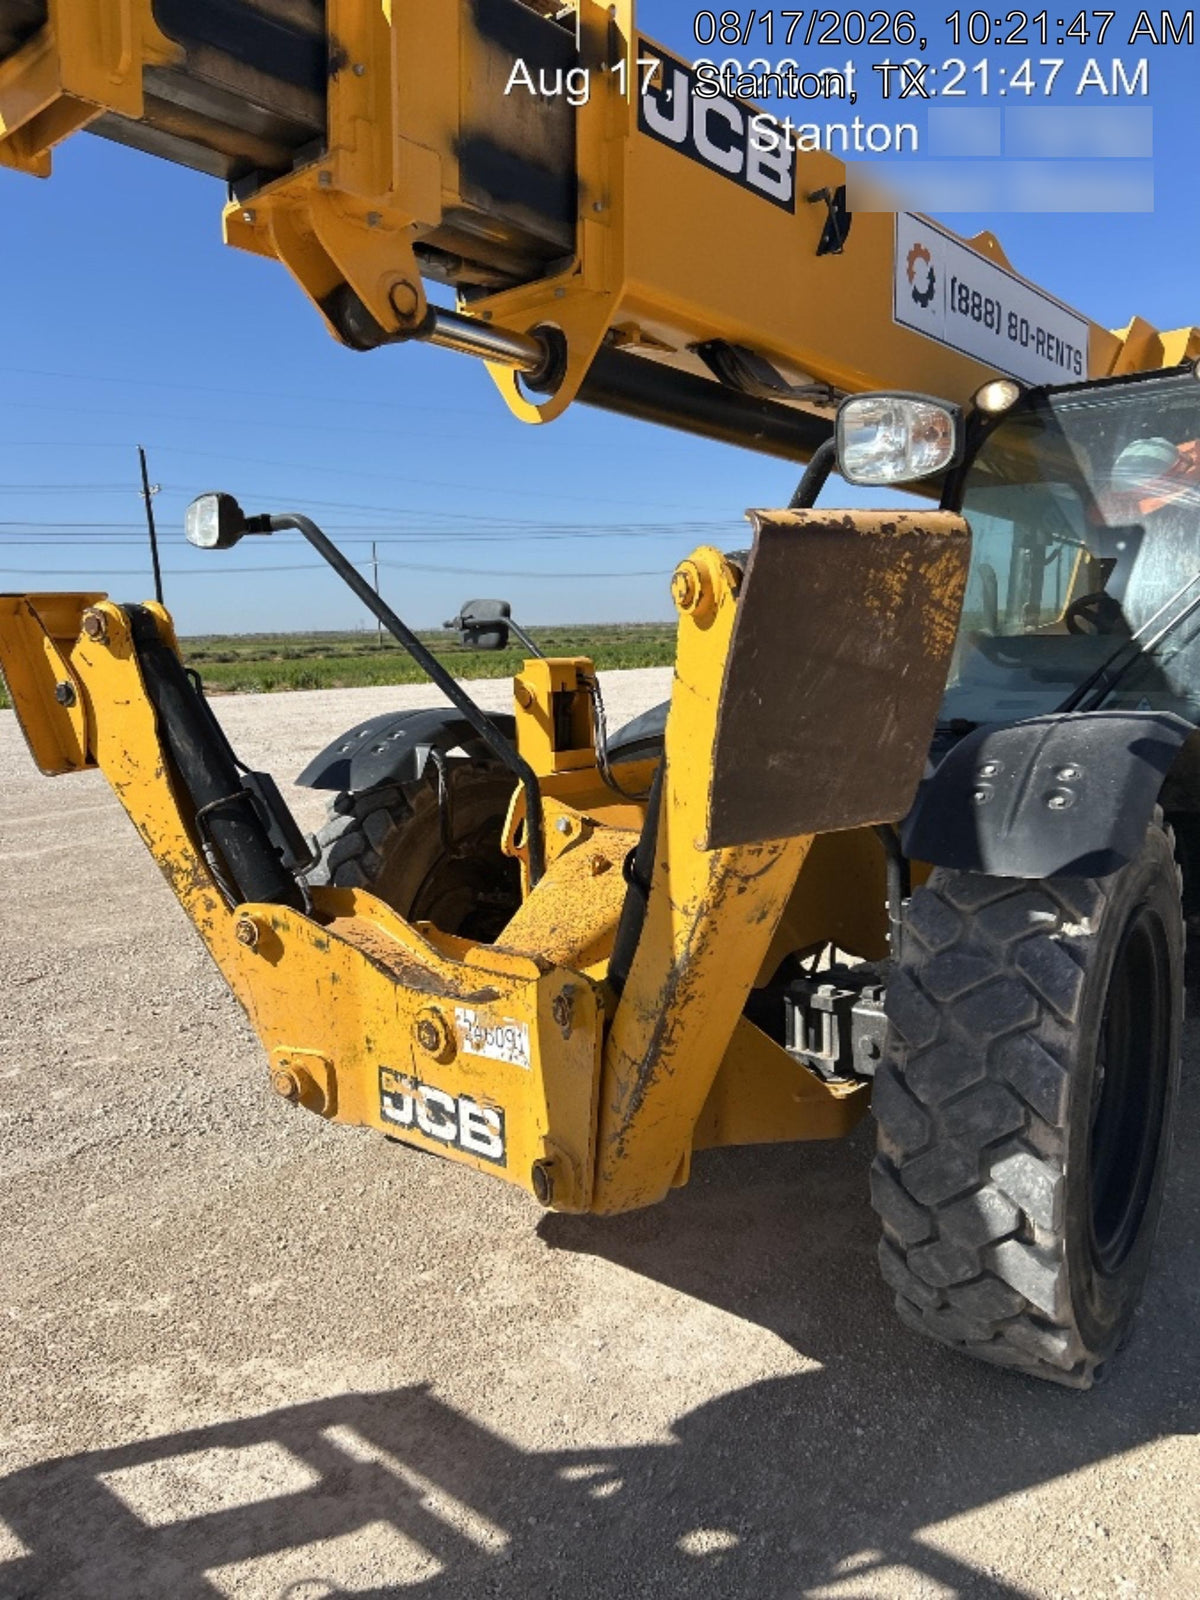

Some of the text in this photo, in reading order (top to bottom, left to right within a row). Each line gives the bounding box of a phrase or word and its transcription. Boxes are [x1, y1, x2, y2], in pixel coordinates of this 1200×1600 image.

[643, 69, 792, 202] JCB
[950, 275, 1082, 376] (888) 80-RENTS
[382, 1073, 504, 1159] JCB
